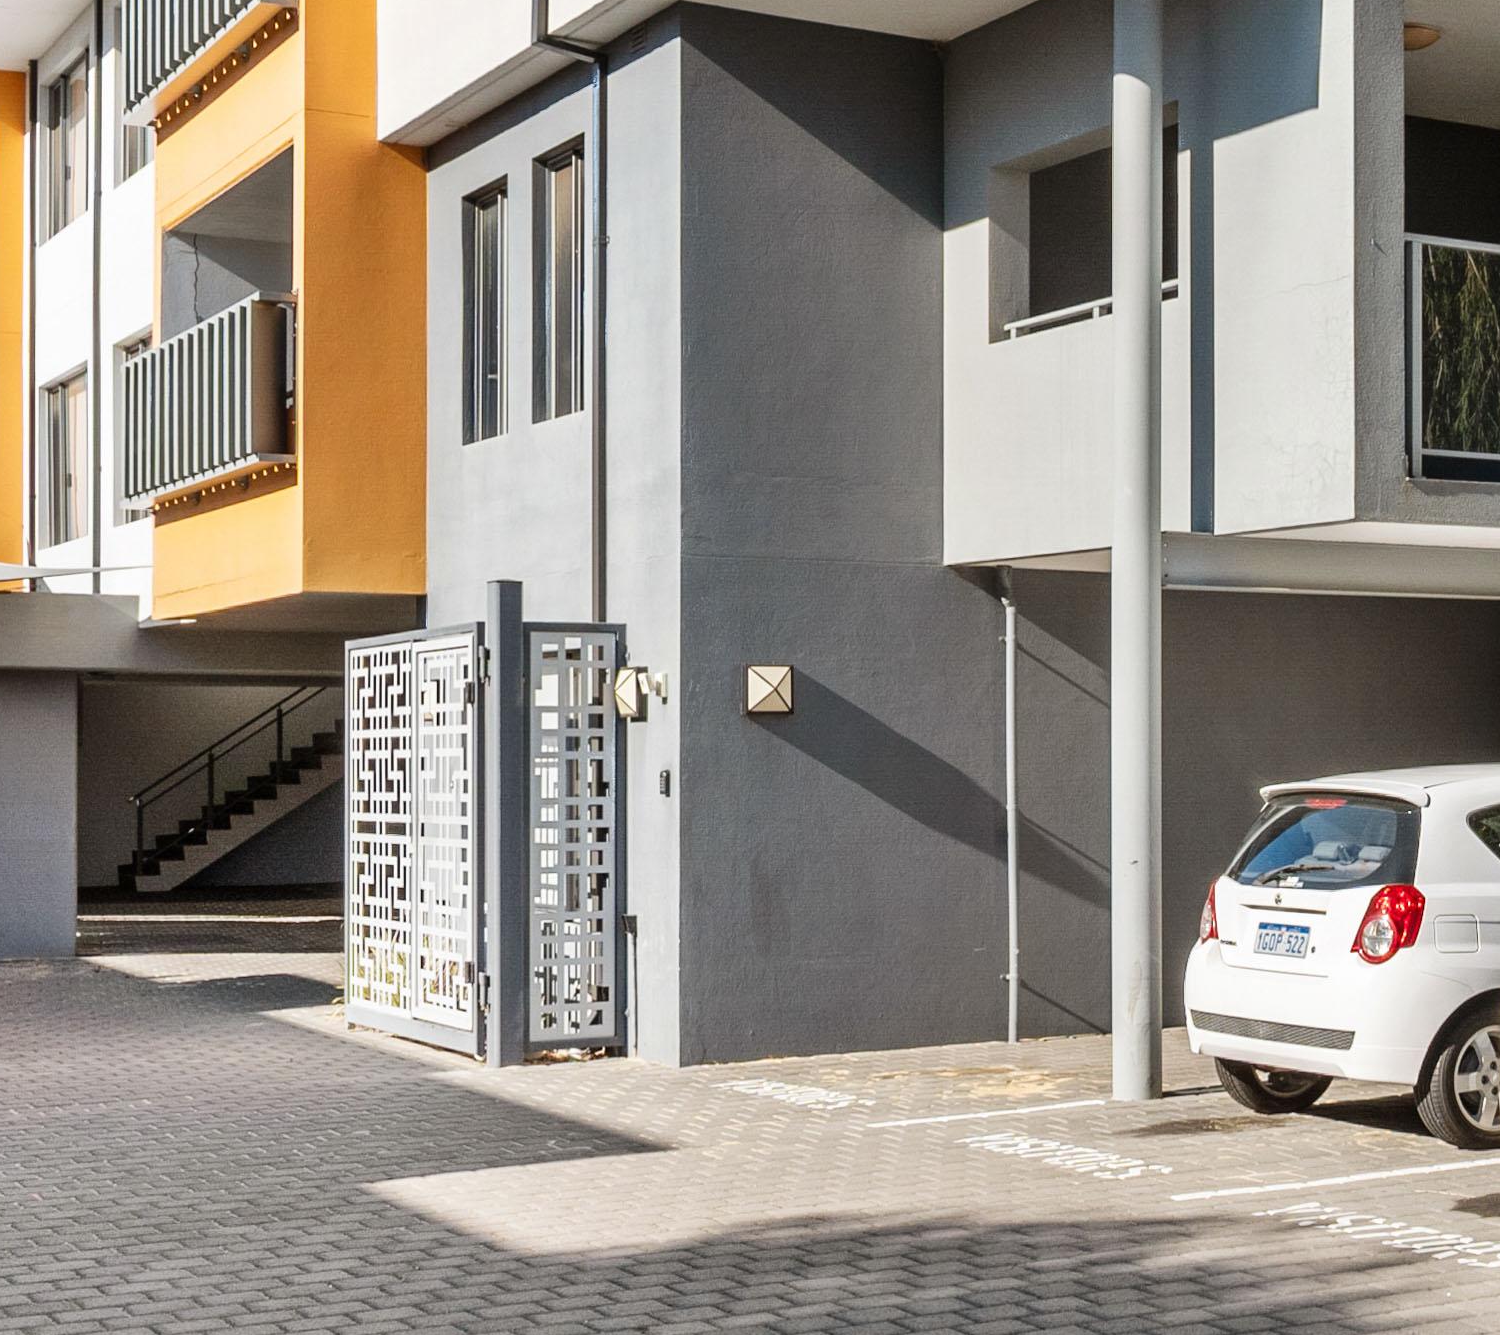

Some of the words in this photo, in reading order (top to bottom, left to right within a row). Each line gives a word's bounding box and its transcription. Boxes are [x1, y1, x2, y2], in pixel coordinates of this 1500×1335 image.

[1285, 934, 1306, 954] 522
[710, 1078, 877, 1111] VISITORS
[954, 1132, 1173, 1180] VISITORS
